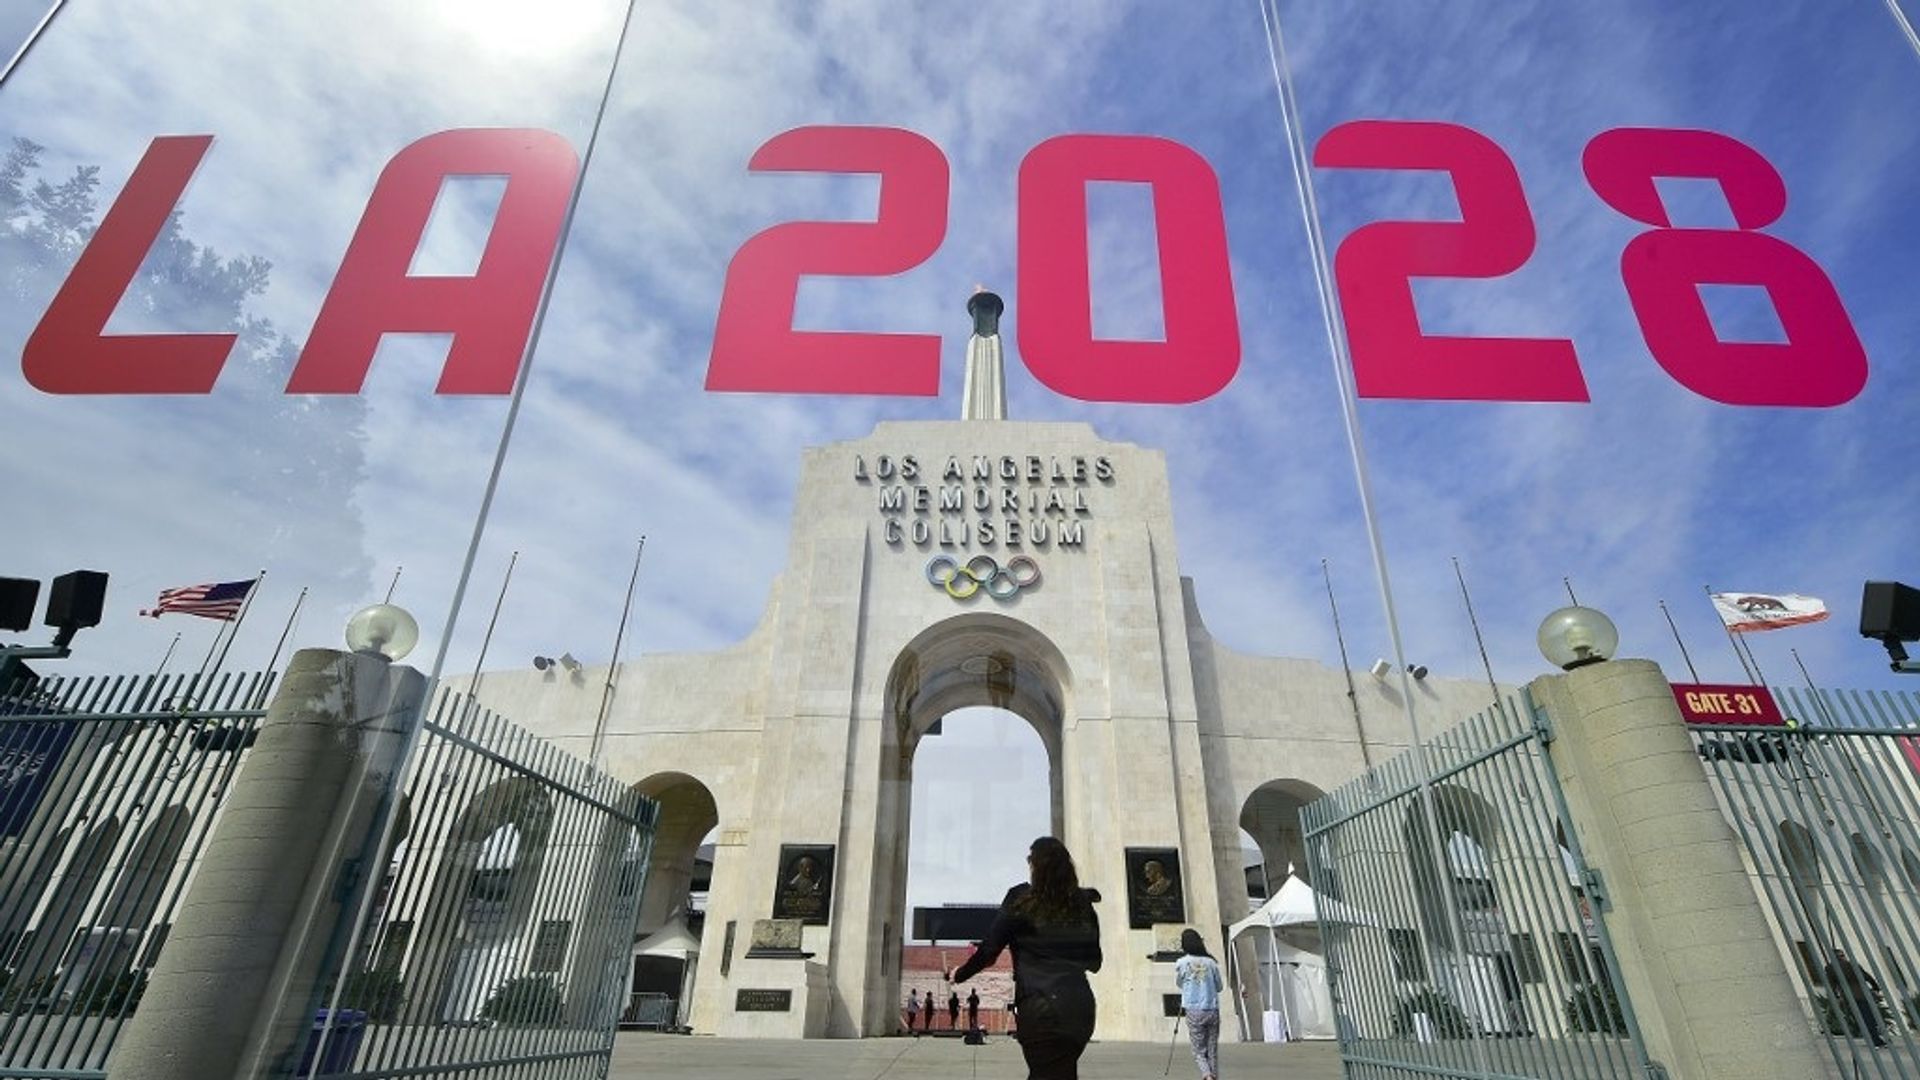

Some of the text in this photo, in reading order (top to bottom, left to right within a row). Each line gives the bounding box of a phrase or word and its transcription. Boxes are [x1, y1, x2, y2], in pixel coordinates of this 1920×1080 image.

[21, 119, 1869, 409] LA 2028
[855, 455, 1114, 482] LOS ANGELES
[880, 486, 1089, 513] MEMORIAL
[885, 518, 1084, 546] COLISEUM
[1685, 691, 1762, 715] GATE 31
